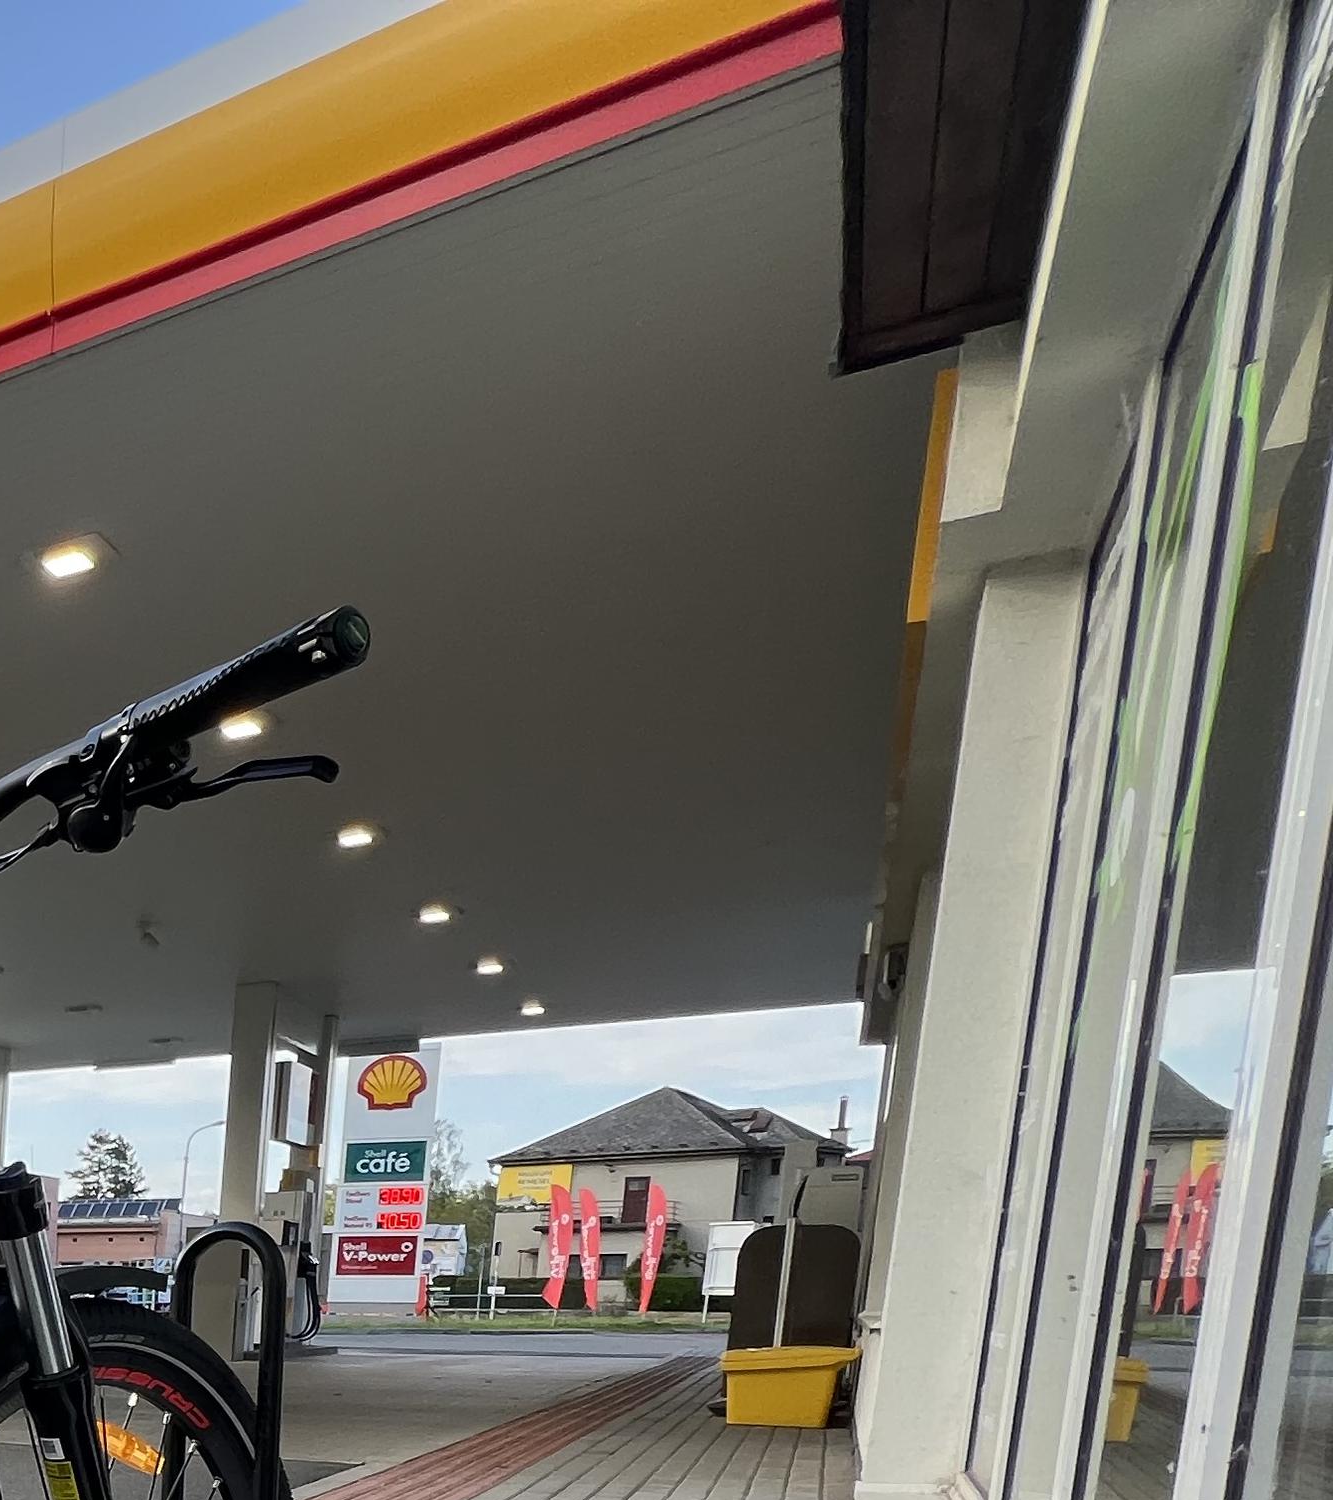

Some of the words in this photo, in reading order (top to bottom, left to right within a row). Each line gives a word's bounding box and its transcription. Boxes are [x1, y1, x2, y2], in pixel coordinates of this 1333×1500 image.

[364, 1149, 387, 1159] Shell
[356, 1151, 411, 1174] café
[343, 1242, 368, 1251] Shell
[343, 1251, 408, 1262] V-Power
[91, 1366, 211, 1430] CRUSSI
